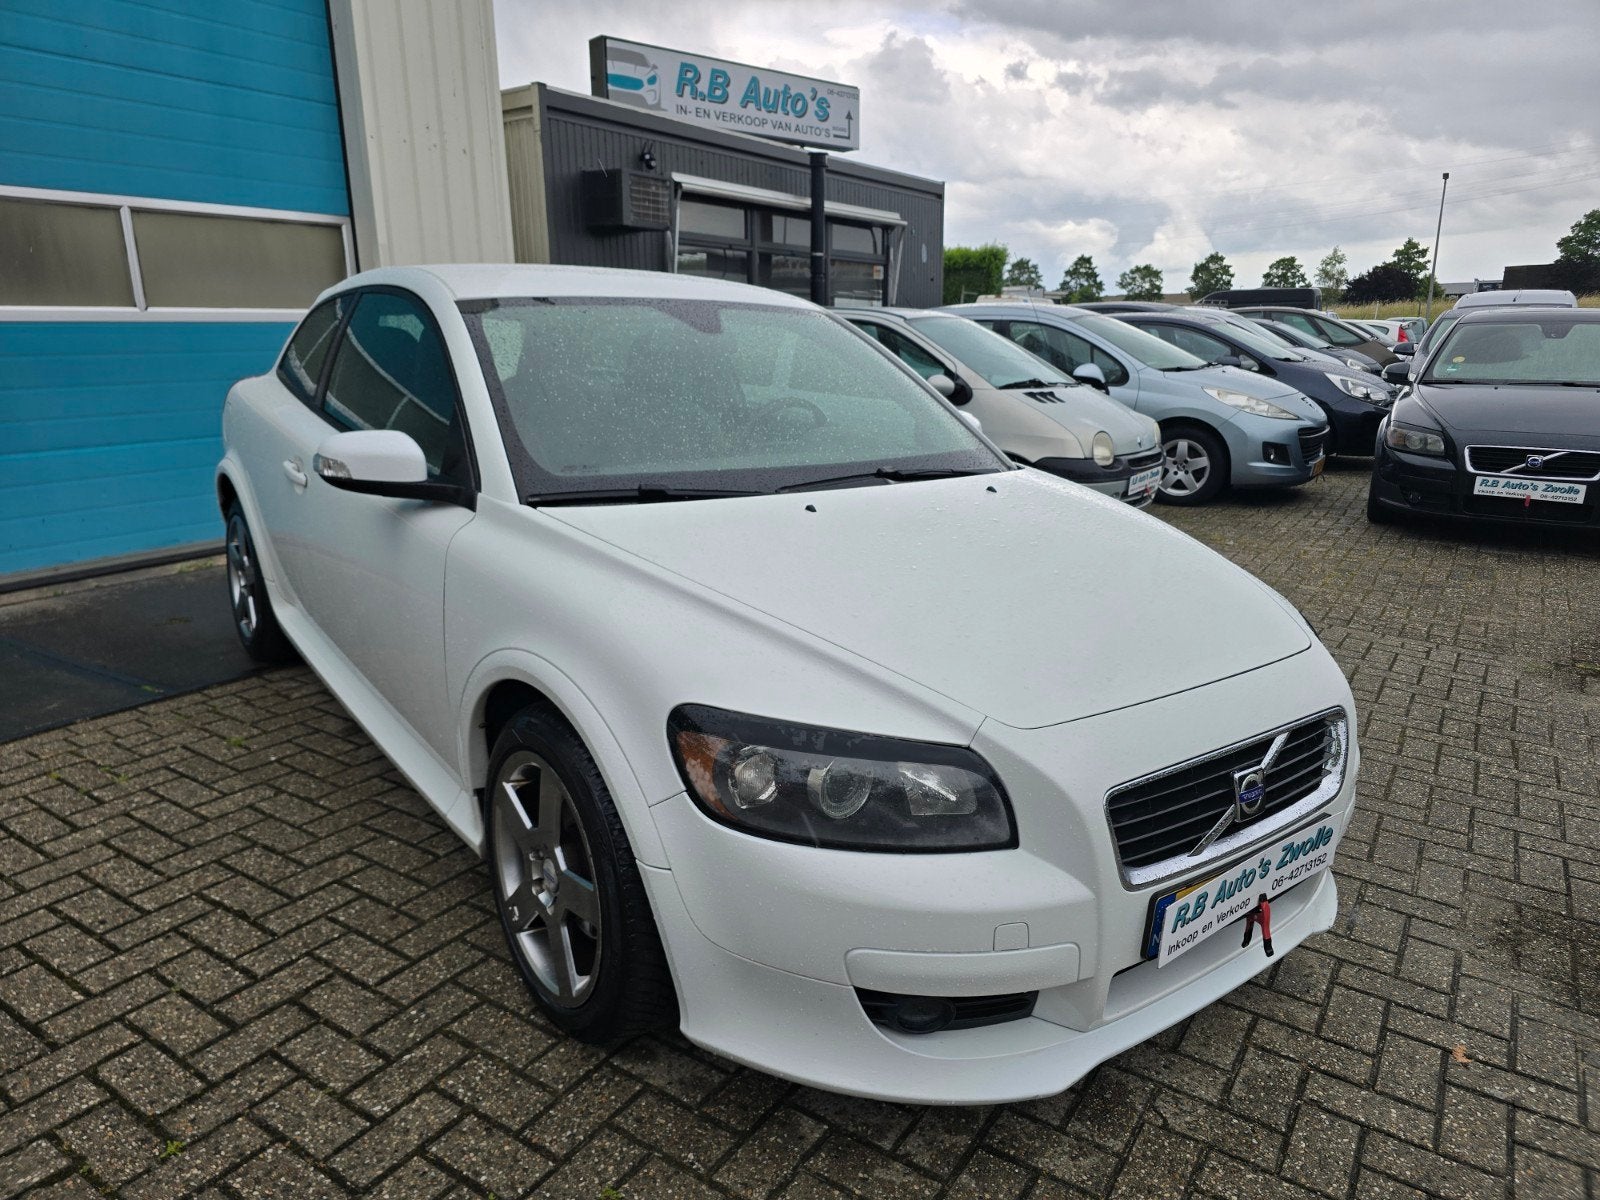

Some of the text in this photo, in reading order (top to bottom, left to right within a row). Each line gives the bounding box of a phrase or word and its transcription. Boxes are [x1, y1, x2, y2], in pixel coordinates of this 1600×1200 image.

[676, 62, 831, 122] R.B Auto's
[675, 104, 692, 115] IN-
[695, 107, 711, 119] EN
[714, 110, 768, 128] VERKOOP
[771, 119, 792, 132] VAN
[794, 124, 831, 138] AUTO'S
[1480, 478, 1580, 495] R.B Auto's Zwolle
[1171, 826, 1334, 933] R.B Auto's Zwolle
[1271, 853, 1327, 891] 06-42713152
[1167, 898, 1251, 956] Inkoop en Verkoop
